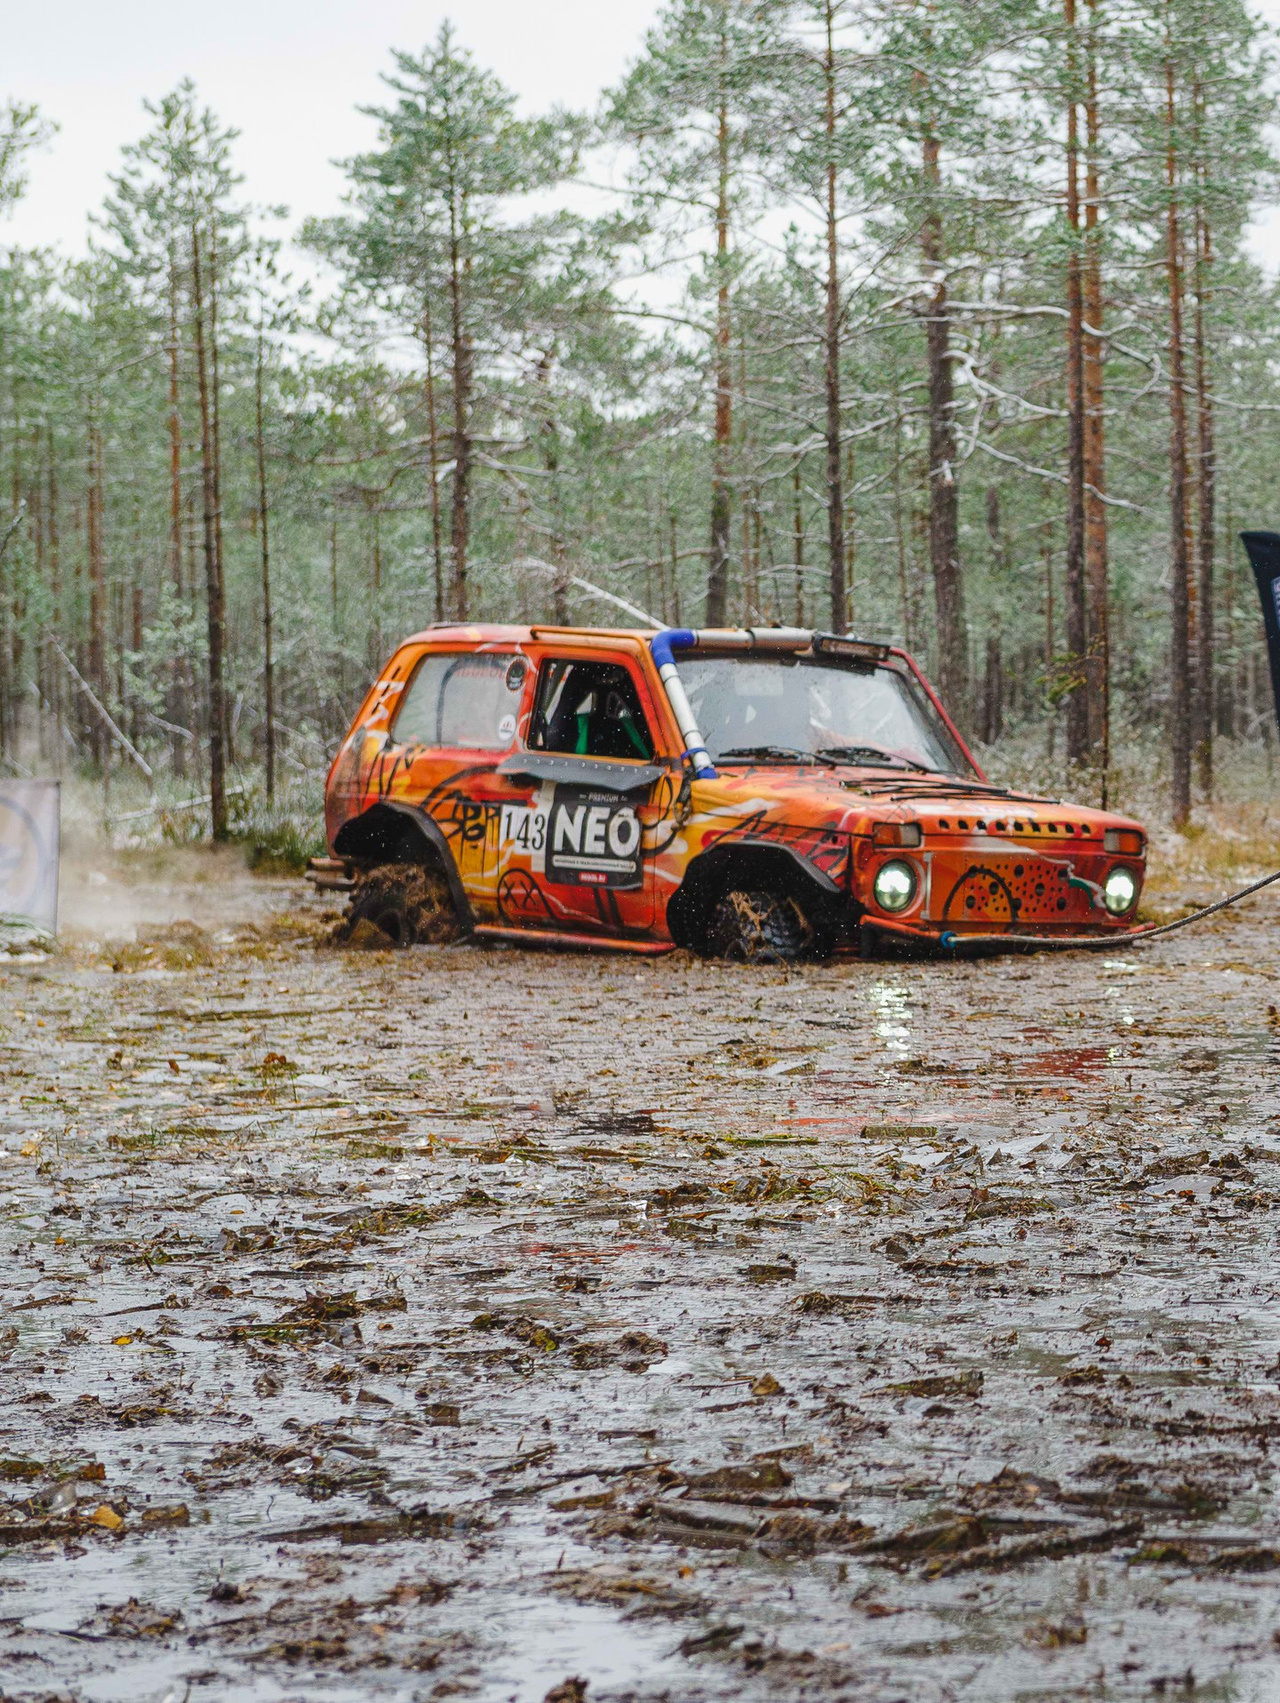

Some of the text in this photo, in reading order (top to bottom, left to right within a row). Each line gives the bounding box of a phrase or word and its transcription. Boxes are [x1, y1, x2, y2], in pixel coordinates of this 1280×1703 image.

[588, 792, 619, 802] PREMIUM
[505, 811, 546, 850] 143
[553, 804, 640, 857] NEO
